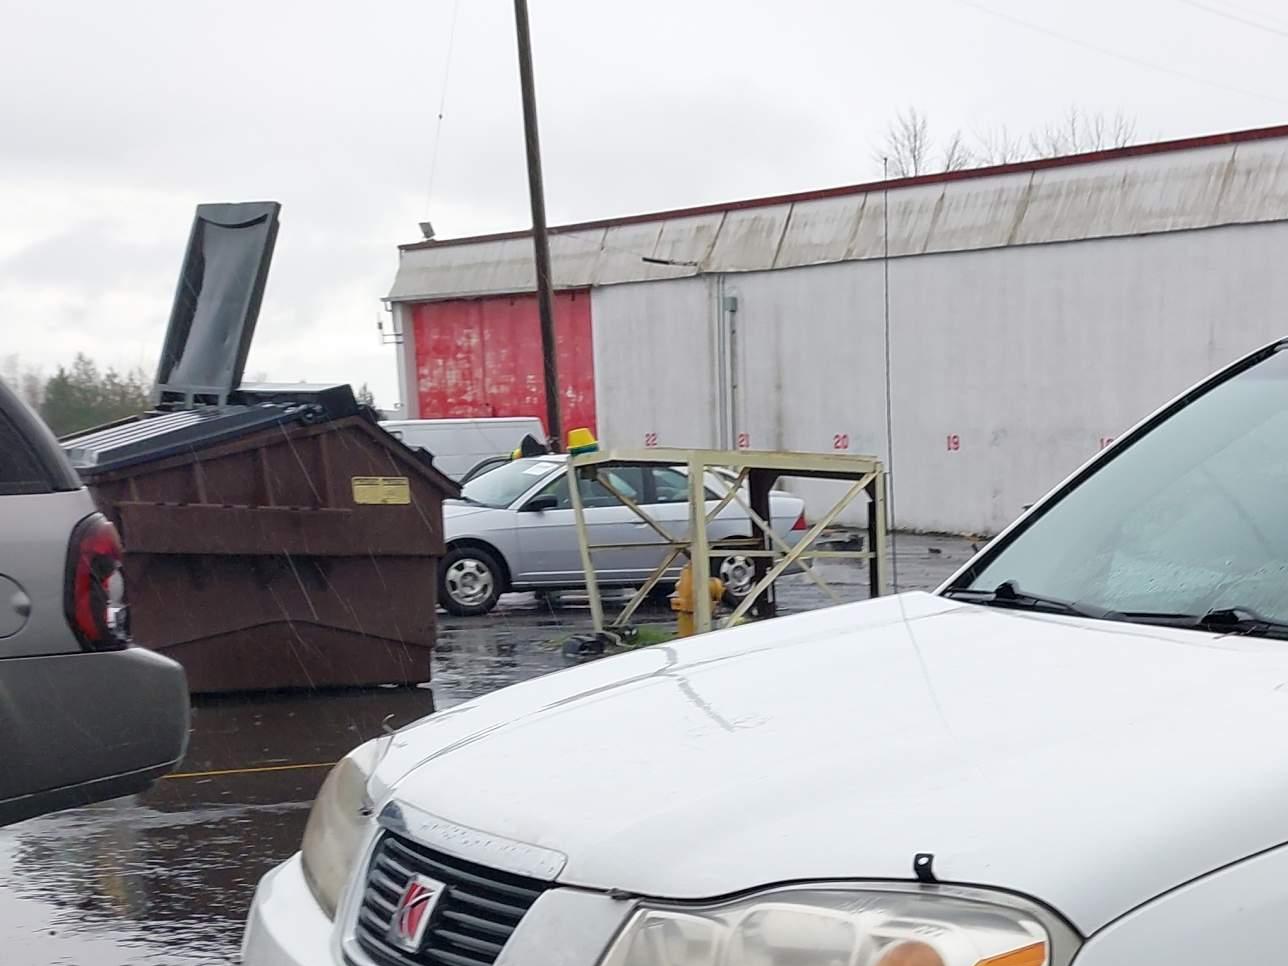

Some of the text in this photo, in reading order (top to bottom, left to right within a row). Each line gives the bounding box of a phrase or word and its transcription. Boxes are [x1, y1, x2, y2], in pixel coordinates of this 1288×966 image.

[644, 432, 658, 447] 22
[738, 433, 750, 448] 21
[833, 434, 849, 449] 20
[946, 434, 960, 451] 19
